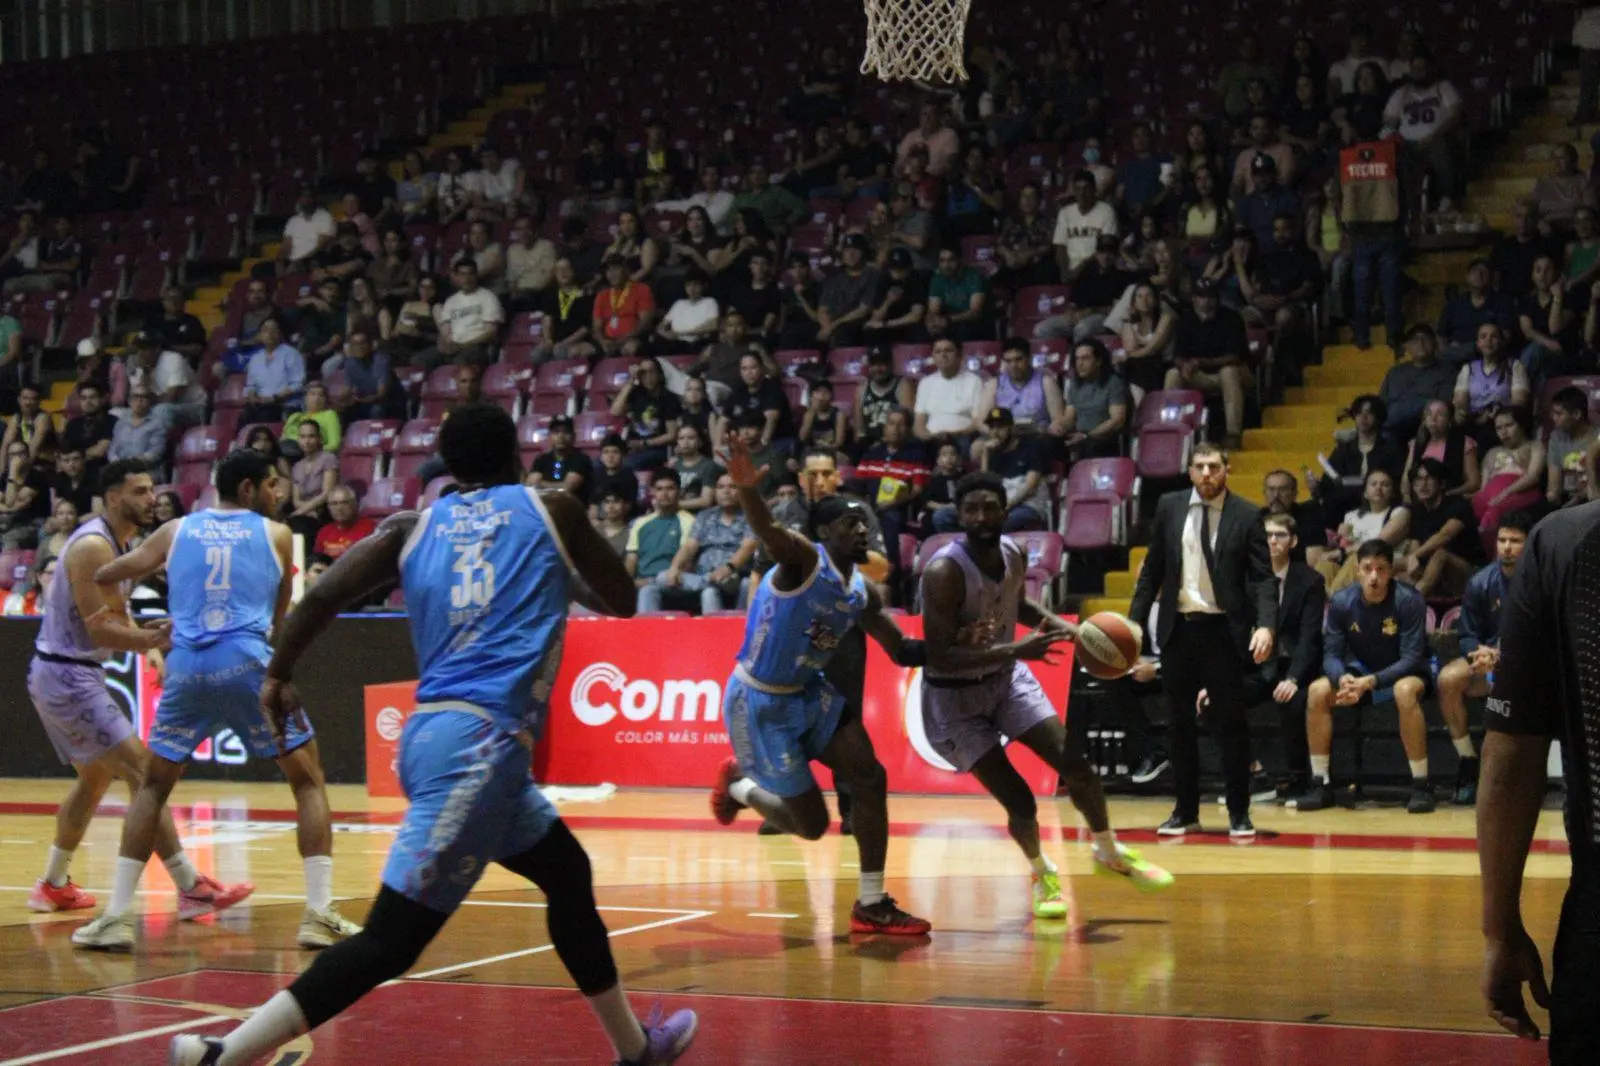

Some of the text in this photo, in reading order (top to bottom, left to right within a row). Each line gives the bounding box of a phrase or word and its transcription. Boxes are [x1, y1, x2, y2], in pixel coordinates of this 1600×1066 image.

[205, 545, 231, 591] 21
[615, 731, 663, 744] COLOR
[668, 729, 698, 744] MÁS
